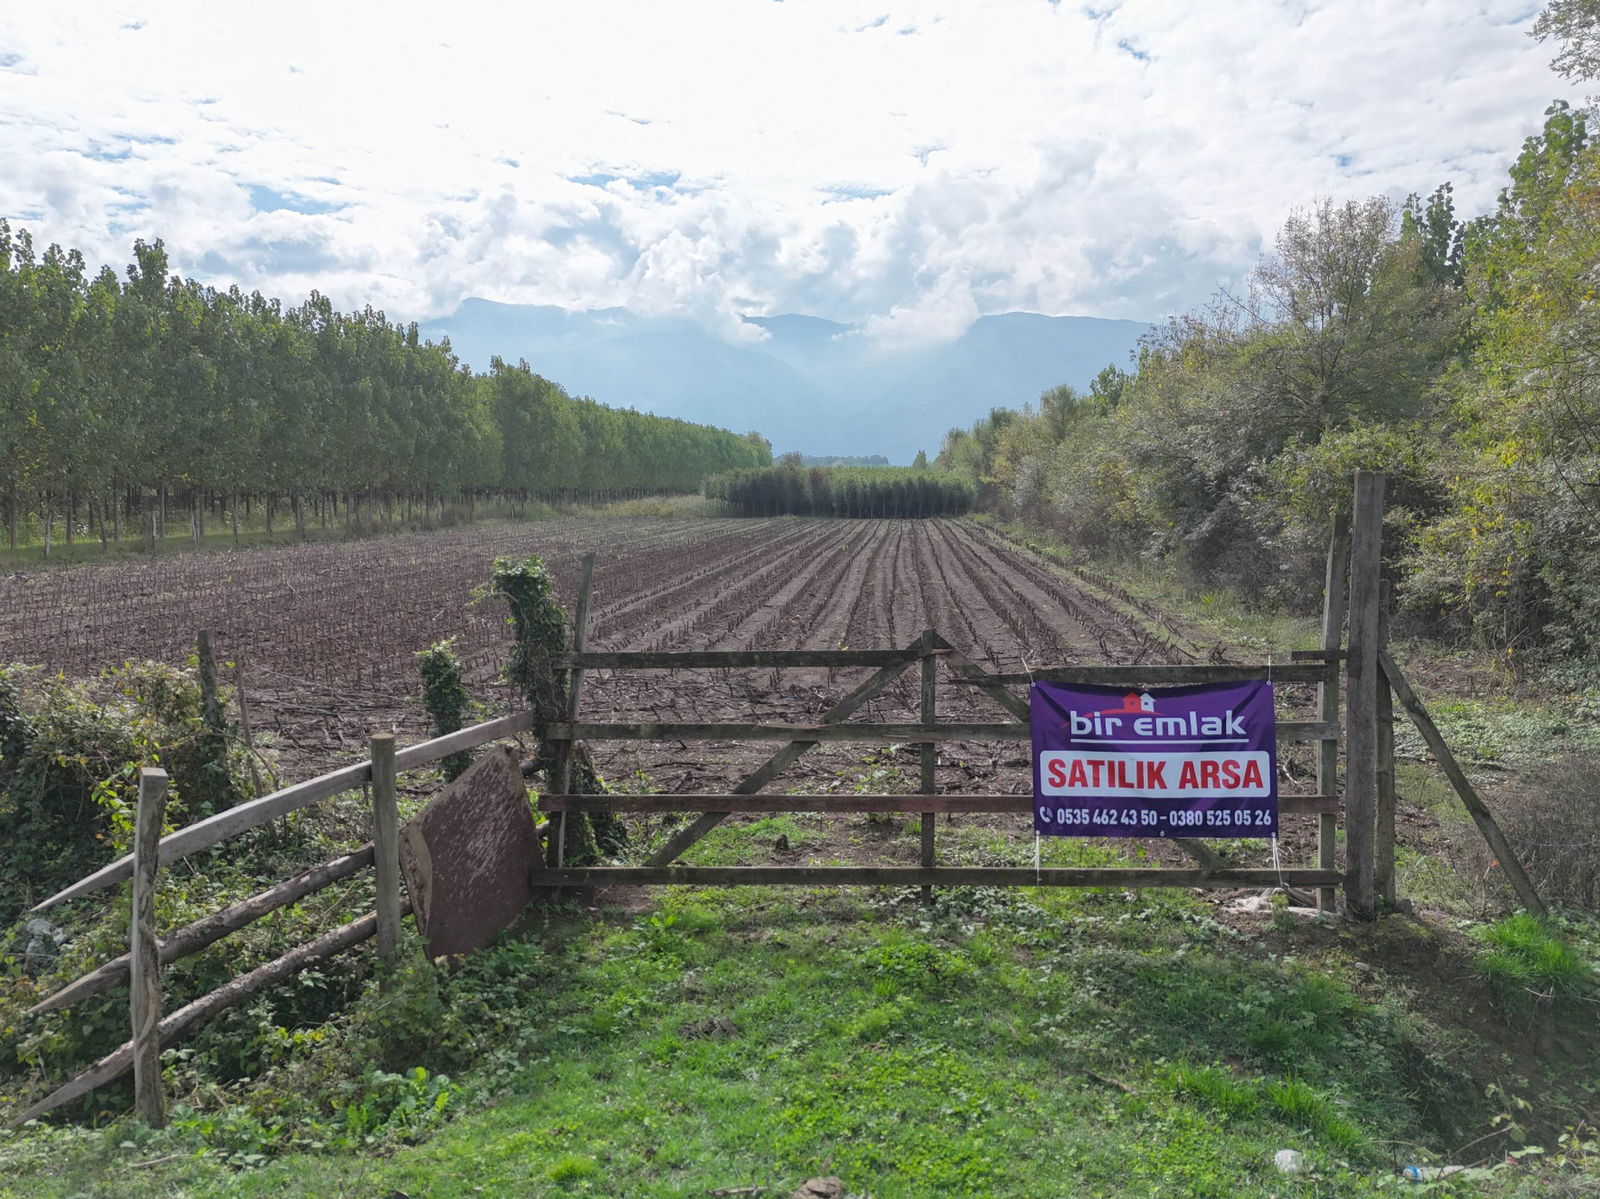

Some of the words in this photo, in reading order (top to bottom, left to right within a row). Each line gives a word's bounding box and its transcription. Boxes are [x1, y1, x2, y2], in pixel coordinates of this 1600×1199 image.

[1069, 710, 1123, 737] bir
[1134, 709, 1247, 737] emlak
[1047, 758, 1168, 790] SATILIK
[1178, 759, 1264, 790] ARSA
[1056, 808, 1090, 825] 0535
[1092, 808, 1118, 825] 462
[1120, 809, 1138, 826] 43
[1140, 809, 1158, 826] 50
[1169, 810, 1203, 826] 0380
[1206, 809, 1231, 826] 525
[1234, 809, 1251, 826] 05
[1254, 809, 1272, 826] 26
